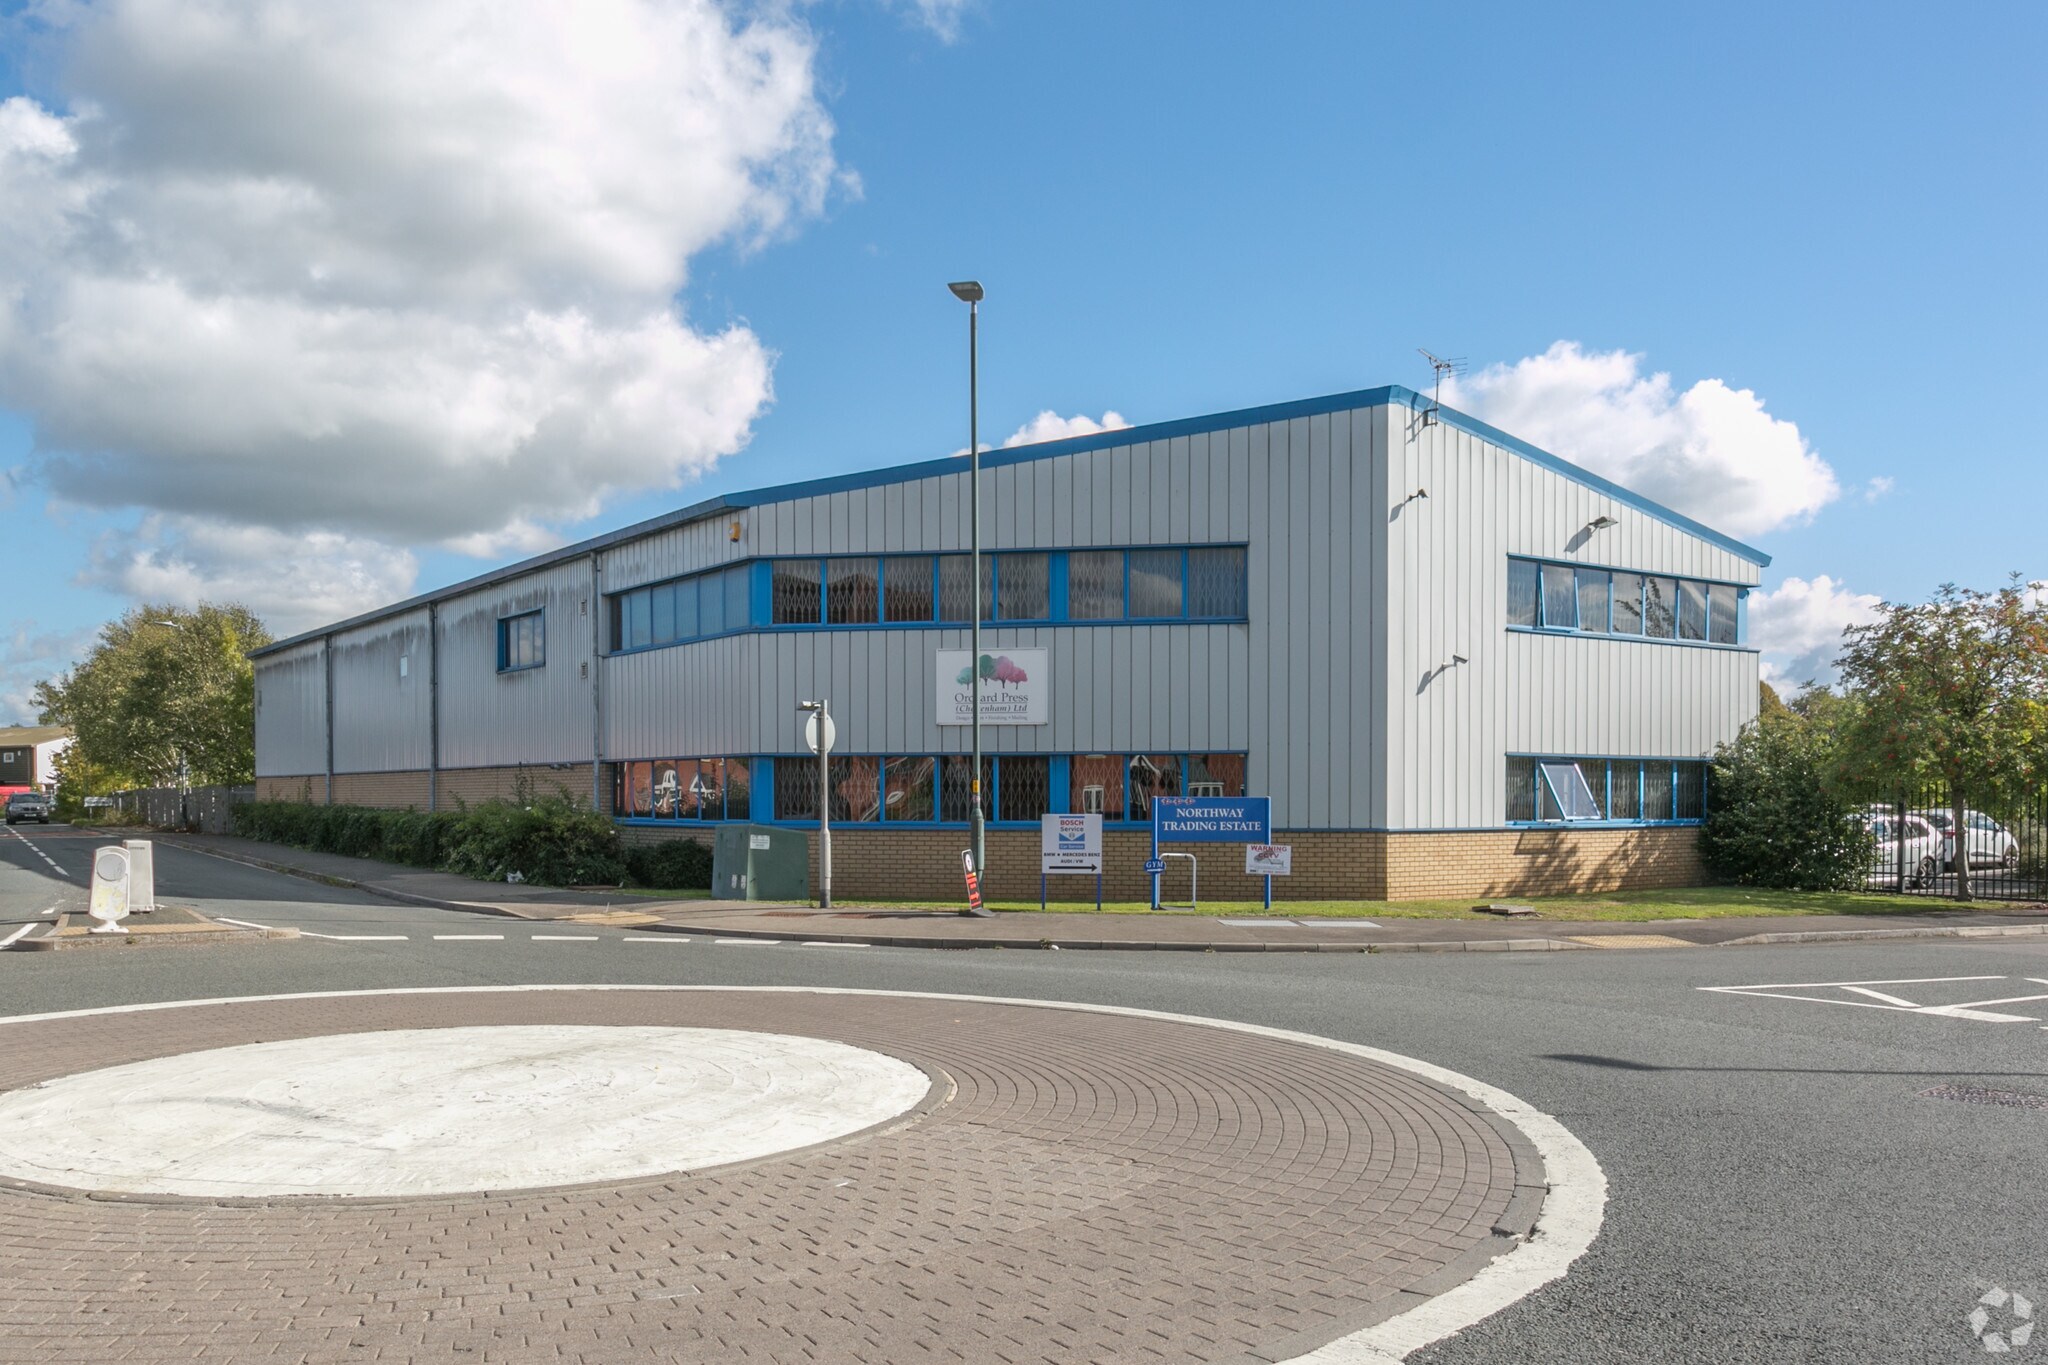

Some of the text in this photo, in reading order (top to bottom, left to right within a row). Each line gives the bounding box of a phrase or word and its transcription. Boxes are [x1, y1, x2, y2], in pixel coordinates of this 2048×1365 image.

[954, 692, 1029, 703] Orcard Press
[955, 704, 1028, 713] (Cheenham) Ltd
[1176, 808, 1244, 818] NORTHWAY
[1162, 821, 1262, 831] TRADING ESTATE
[1250, 845, 1288, 853] WARNING
[1145, 861, 1163, 869] GYM
